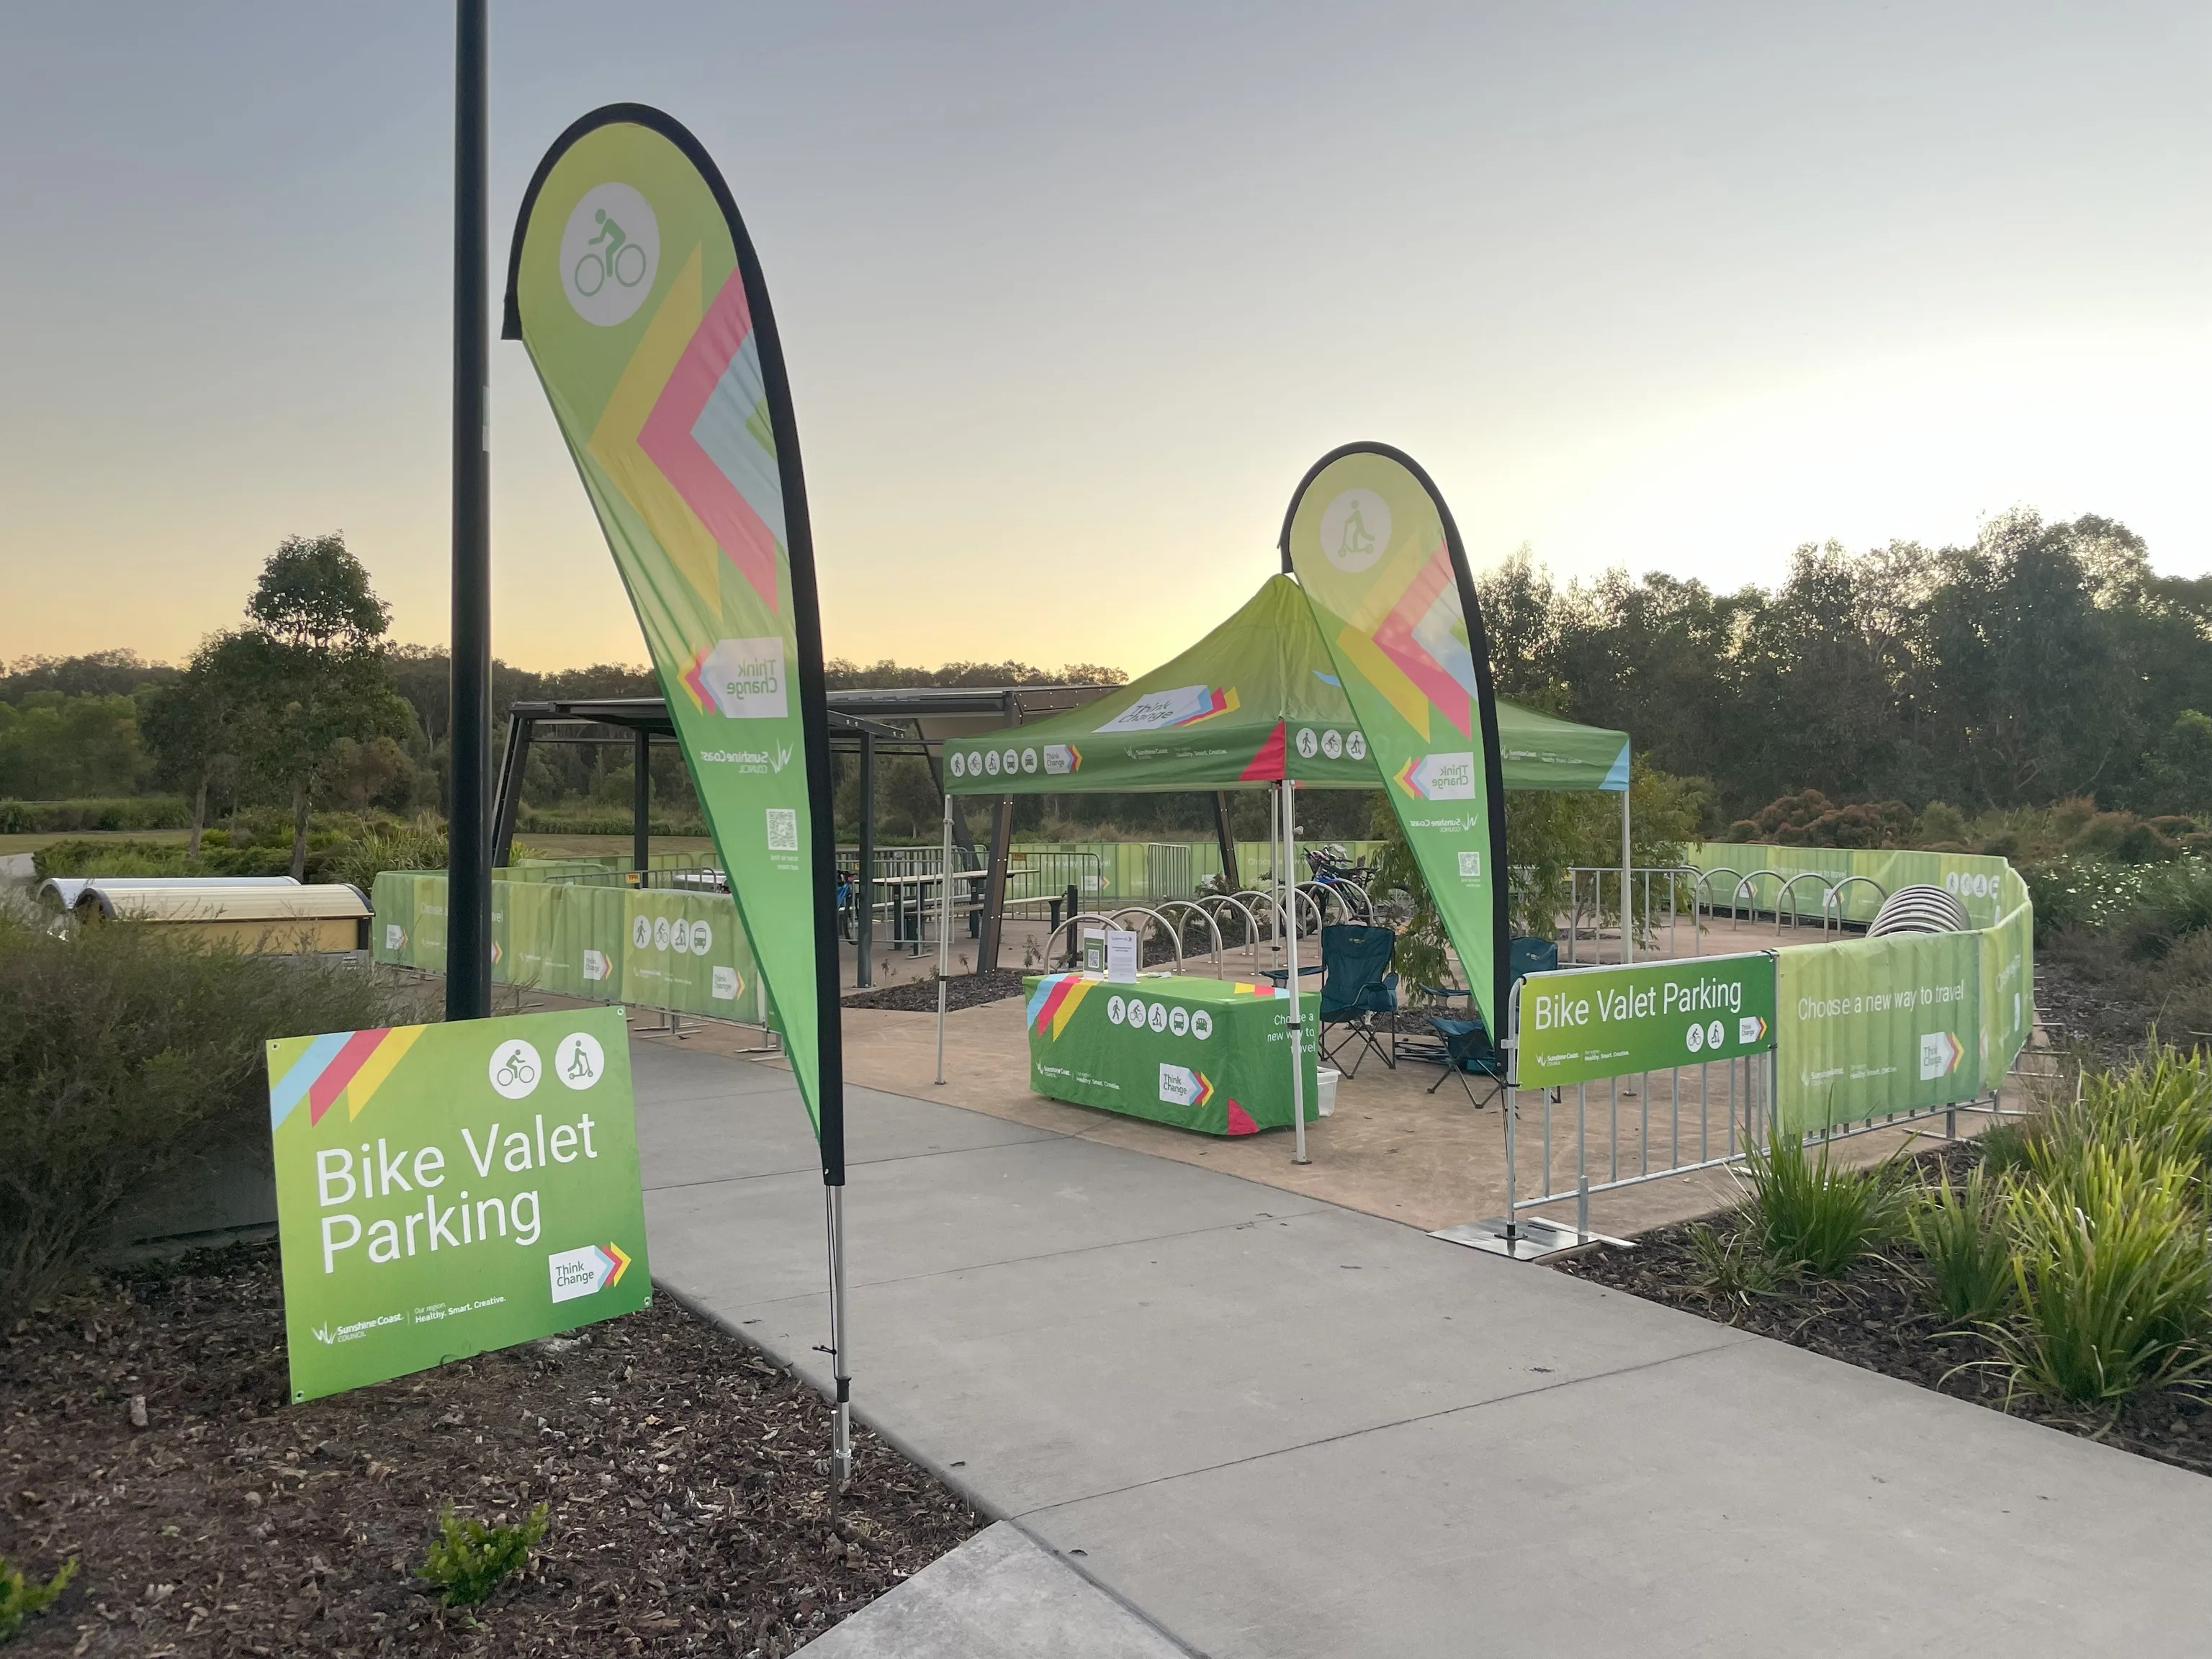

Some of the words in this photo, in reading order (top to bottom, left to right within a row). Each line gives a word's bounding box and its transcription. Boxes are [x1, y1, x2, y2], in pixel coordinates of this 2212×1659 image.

[1131, 700, 1172, 714] Think
[1118, 711, 1174, 723] Change
[1247, 857, 1272, 866] Choos
[1535, 992, 1590, 1030] Bike
[1596, 984, 1656, 1022] Valet
[1663, 977, 1742, 1014] Parking
[1798, 997, 1851, 1021] Choose
[1854, 997, 1862, 1014] a
[1866, 993, 1891, 1012] new
[1894, 989, 1918, 1012] way
[1920, 986, 1933, 1005] to
[1935, 979, 1965, 1002] travel
[1274, 1013, 1307, 1025] Choe
[1308, 1012, 1314, 1022] a
[1267, 1030, 1284, 1042] new
[1286, 1029, 1303, 1040] wy
[1305, 1027, 1315, 1037] to
[1163, 1074, 1182, 1086] Think
[1163, 1082, 1187, 1096] Change
[317, 1138, 445, 1207] Bike
[461, 1113, 598, 1178] Valet
[321, 1190, 541, 1274] Parking
[556, 1261, 585, 1277] Think
[557, 1271, 594, 1287] Change
[414, 1306, 426, 1315] Our
[415, 1310, 447, 1324] Healthy.
[448, 1302, 472, 1316] Smart.
[473, 1295, 507, 1310] Creative.
[336, 1318, 377, 1336] Sunshine
[377, 1312, 403, 1326] Coast
[337, 1331, 367, 1344] COUNCIL
